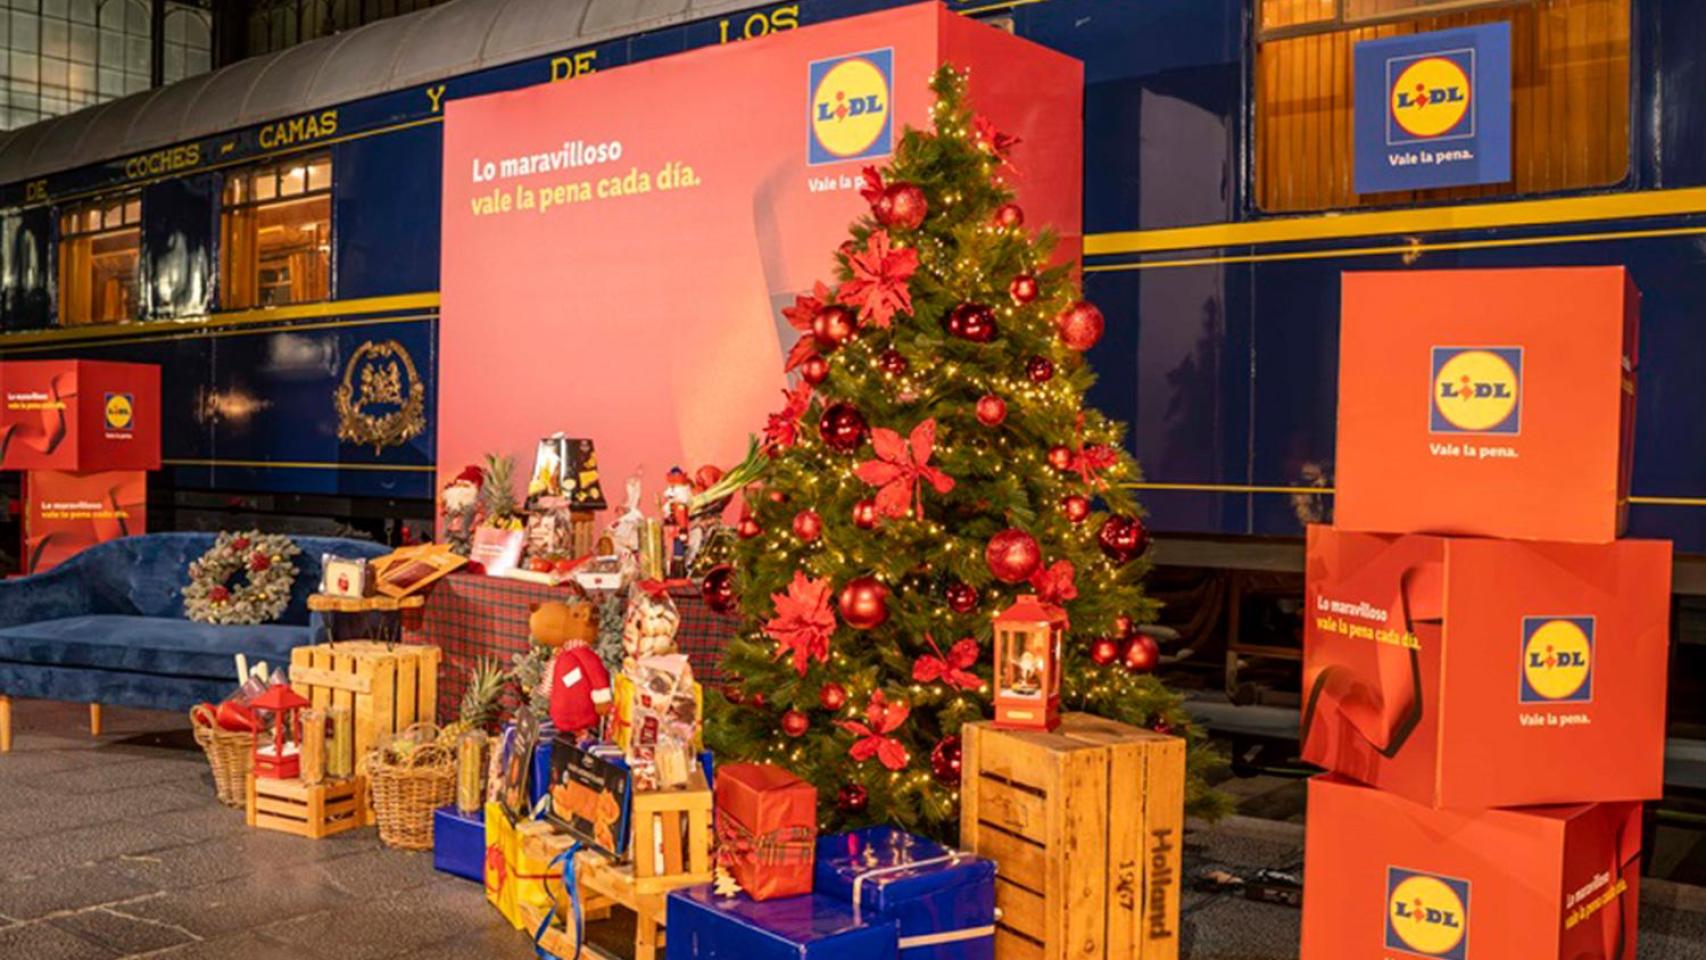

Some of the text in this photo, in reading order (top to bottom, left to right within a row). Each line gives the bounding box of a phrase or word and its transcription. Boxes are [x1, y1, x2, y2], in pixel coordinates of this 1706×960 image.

[125, 144, 200, 178] COCHES
[259, 110, 338, 149] CAMAS
[426, 85, 446, 112] Y
[550, 50, 598, 83] DE
[719, 5, 799, 45] LOS
[1397, 82, 1464, 110] LIDL
[817, 90, 884, 123] LIDL
[472, 140, 623, 182] Lo maravilloso
[1387, 149, 1475, 167] Vale la pena.
[471, 160, 702, 216] vale la pena cada día.
[808, 175, 838, 192] Vale
[839, 174, 852, 190] la
[1441, 375, 1512, 402] LIDL
[1429, 443, 1520, 460] Vale la pena.
[1317, 594, 1388, 622] Lo maravilloso
[1316, 616, 1338, 632] vale
[1338, 618, 1349, 635] la
[1349, 623, 1374, 640] pena
[1529, 645, 1585, 670] LIDL
[1519, 713, 1592, 728] Vale la pena.
[1150, 829, 1172, 940] Holland
[1394, 897, 1459, 929] LIDL
